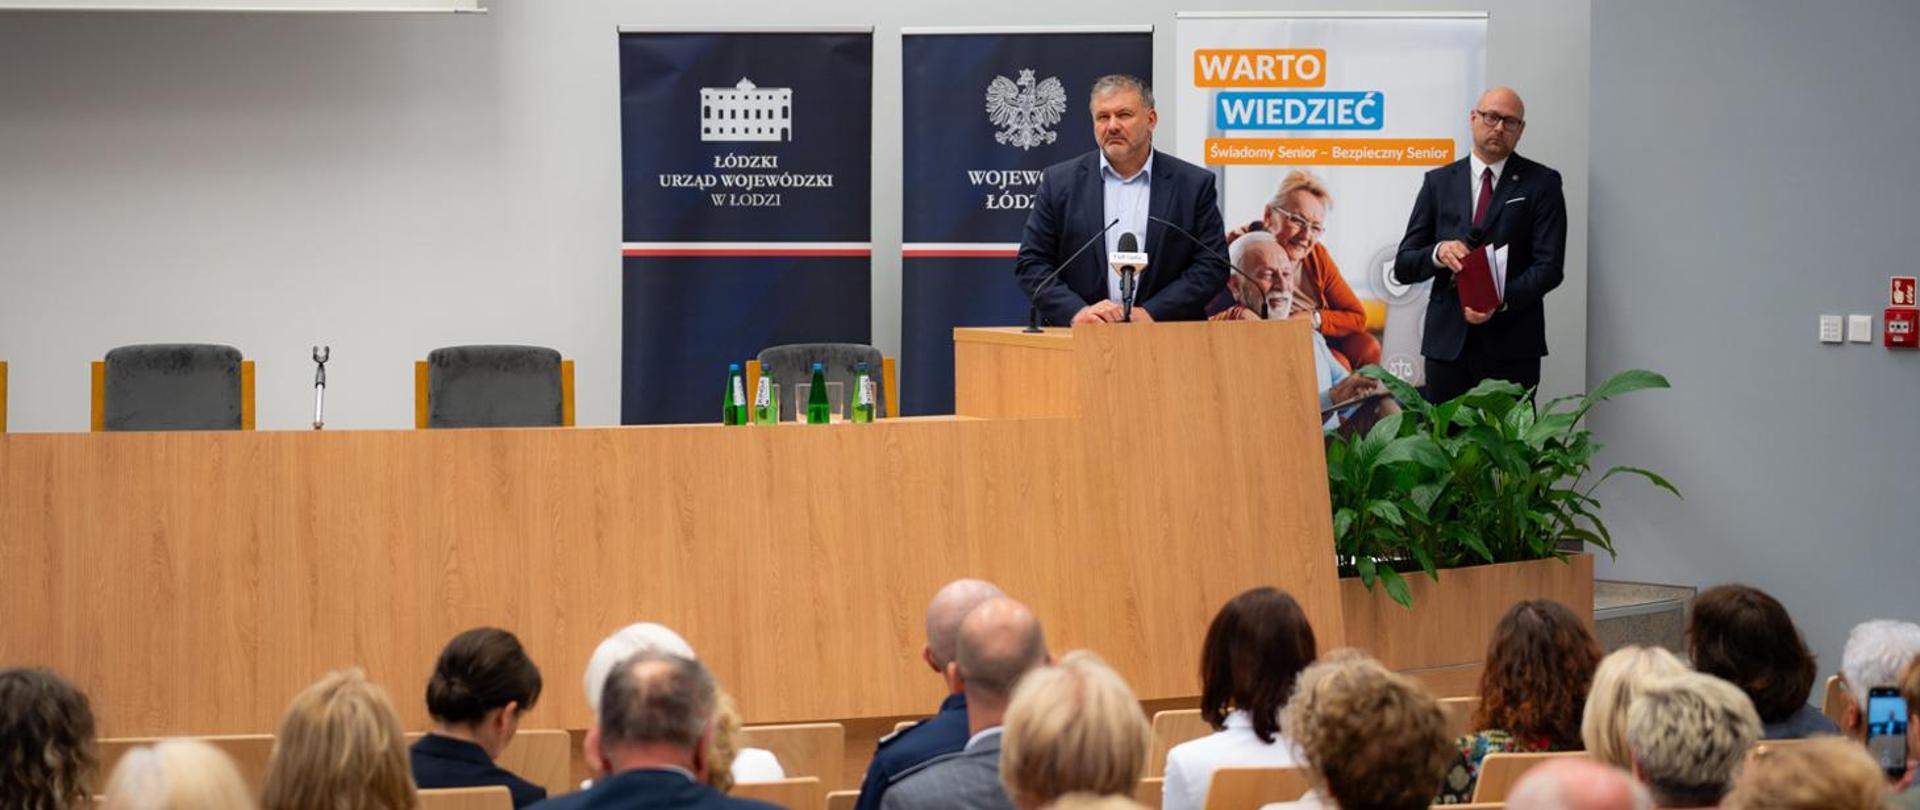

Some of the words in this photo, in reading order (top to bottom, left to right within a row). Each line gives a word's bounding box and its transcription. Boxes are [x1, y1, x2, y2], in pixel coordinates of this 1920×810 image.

[1200, 55, 1321, 81] WARTO
[1220, 92, 1376, 125] WIEDZIEĆ
[714, 152, 778, 168] ŁÓDZKI
[1210, 144, 1274, 160] Świadomy
[1277, 146, 1317, 159] Senior
[1332, 146, 1402, 160] Bezpieczny
[1406, 146, 1449, 159] Senior
[659, 174, 717, 190] URZĄD
[720, 171, 833, 190] WOJEWÓDZKI
[967, 170, 1043, 190] WOJEW
[711, 193, 727, 206] W
[730, 193, 781, 207] ŁODZI
